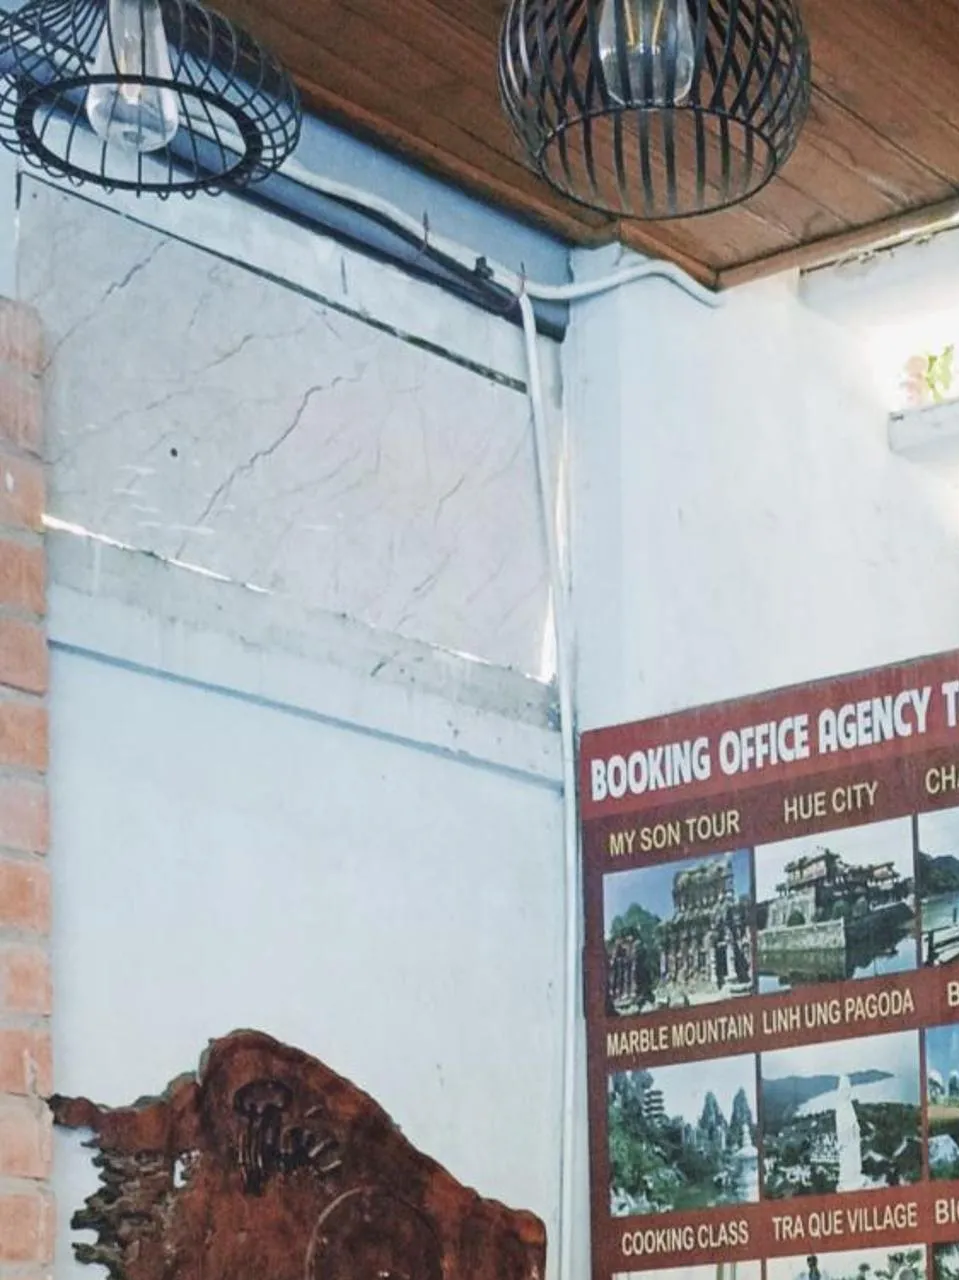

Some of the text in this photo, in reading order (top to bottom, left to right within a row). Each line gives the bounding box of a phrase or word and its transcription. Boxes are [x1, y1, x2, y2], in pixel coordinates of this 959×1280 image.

[591, 736, 711, 801] BOOKING
[719, 713, 810, 775] OFFICE
[818, 686, 933, 753] AGENCY
[784, 781, 878, 823] HUE CITY
[609, 810, 741, 857] MY SON TOUR
[763, 988, 914, 1035] LINH UNG PAGODA
[606, 1014, 754, 1057] MARBLE MOUNTAIN
[622, 1219, 749, 1256] COOKING CLASS
[772, 1202, 918, 1241] TRA QUE VILLAGE
